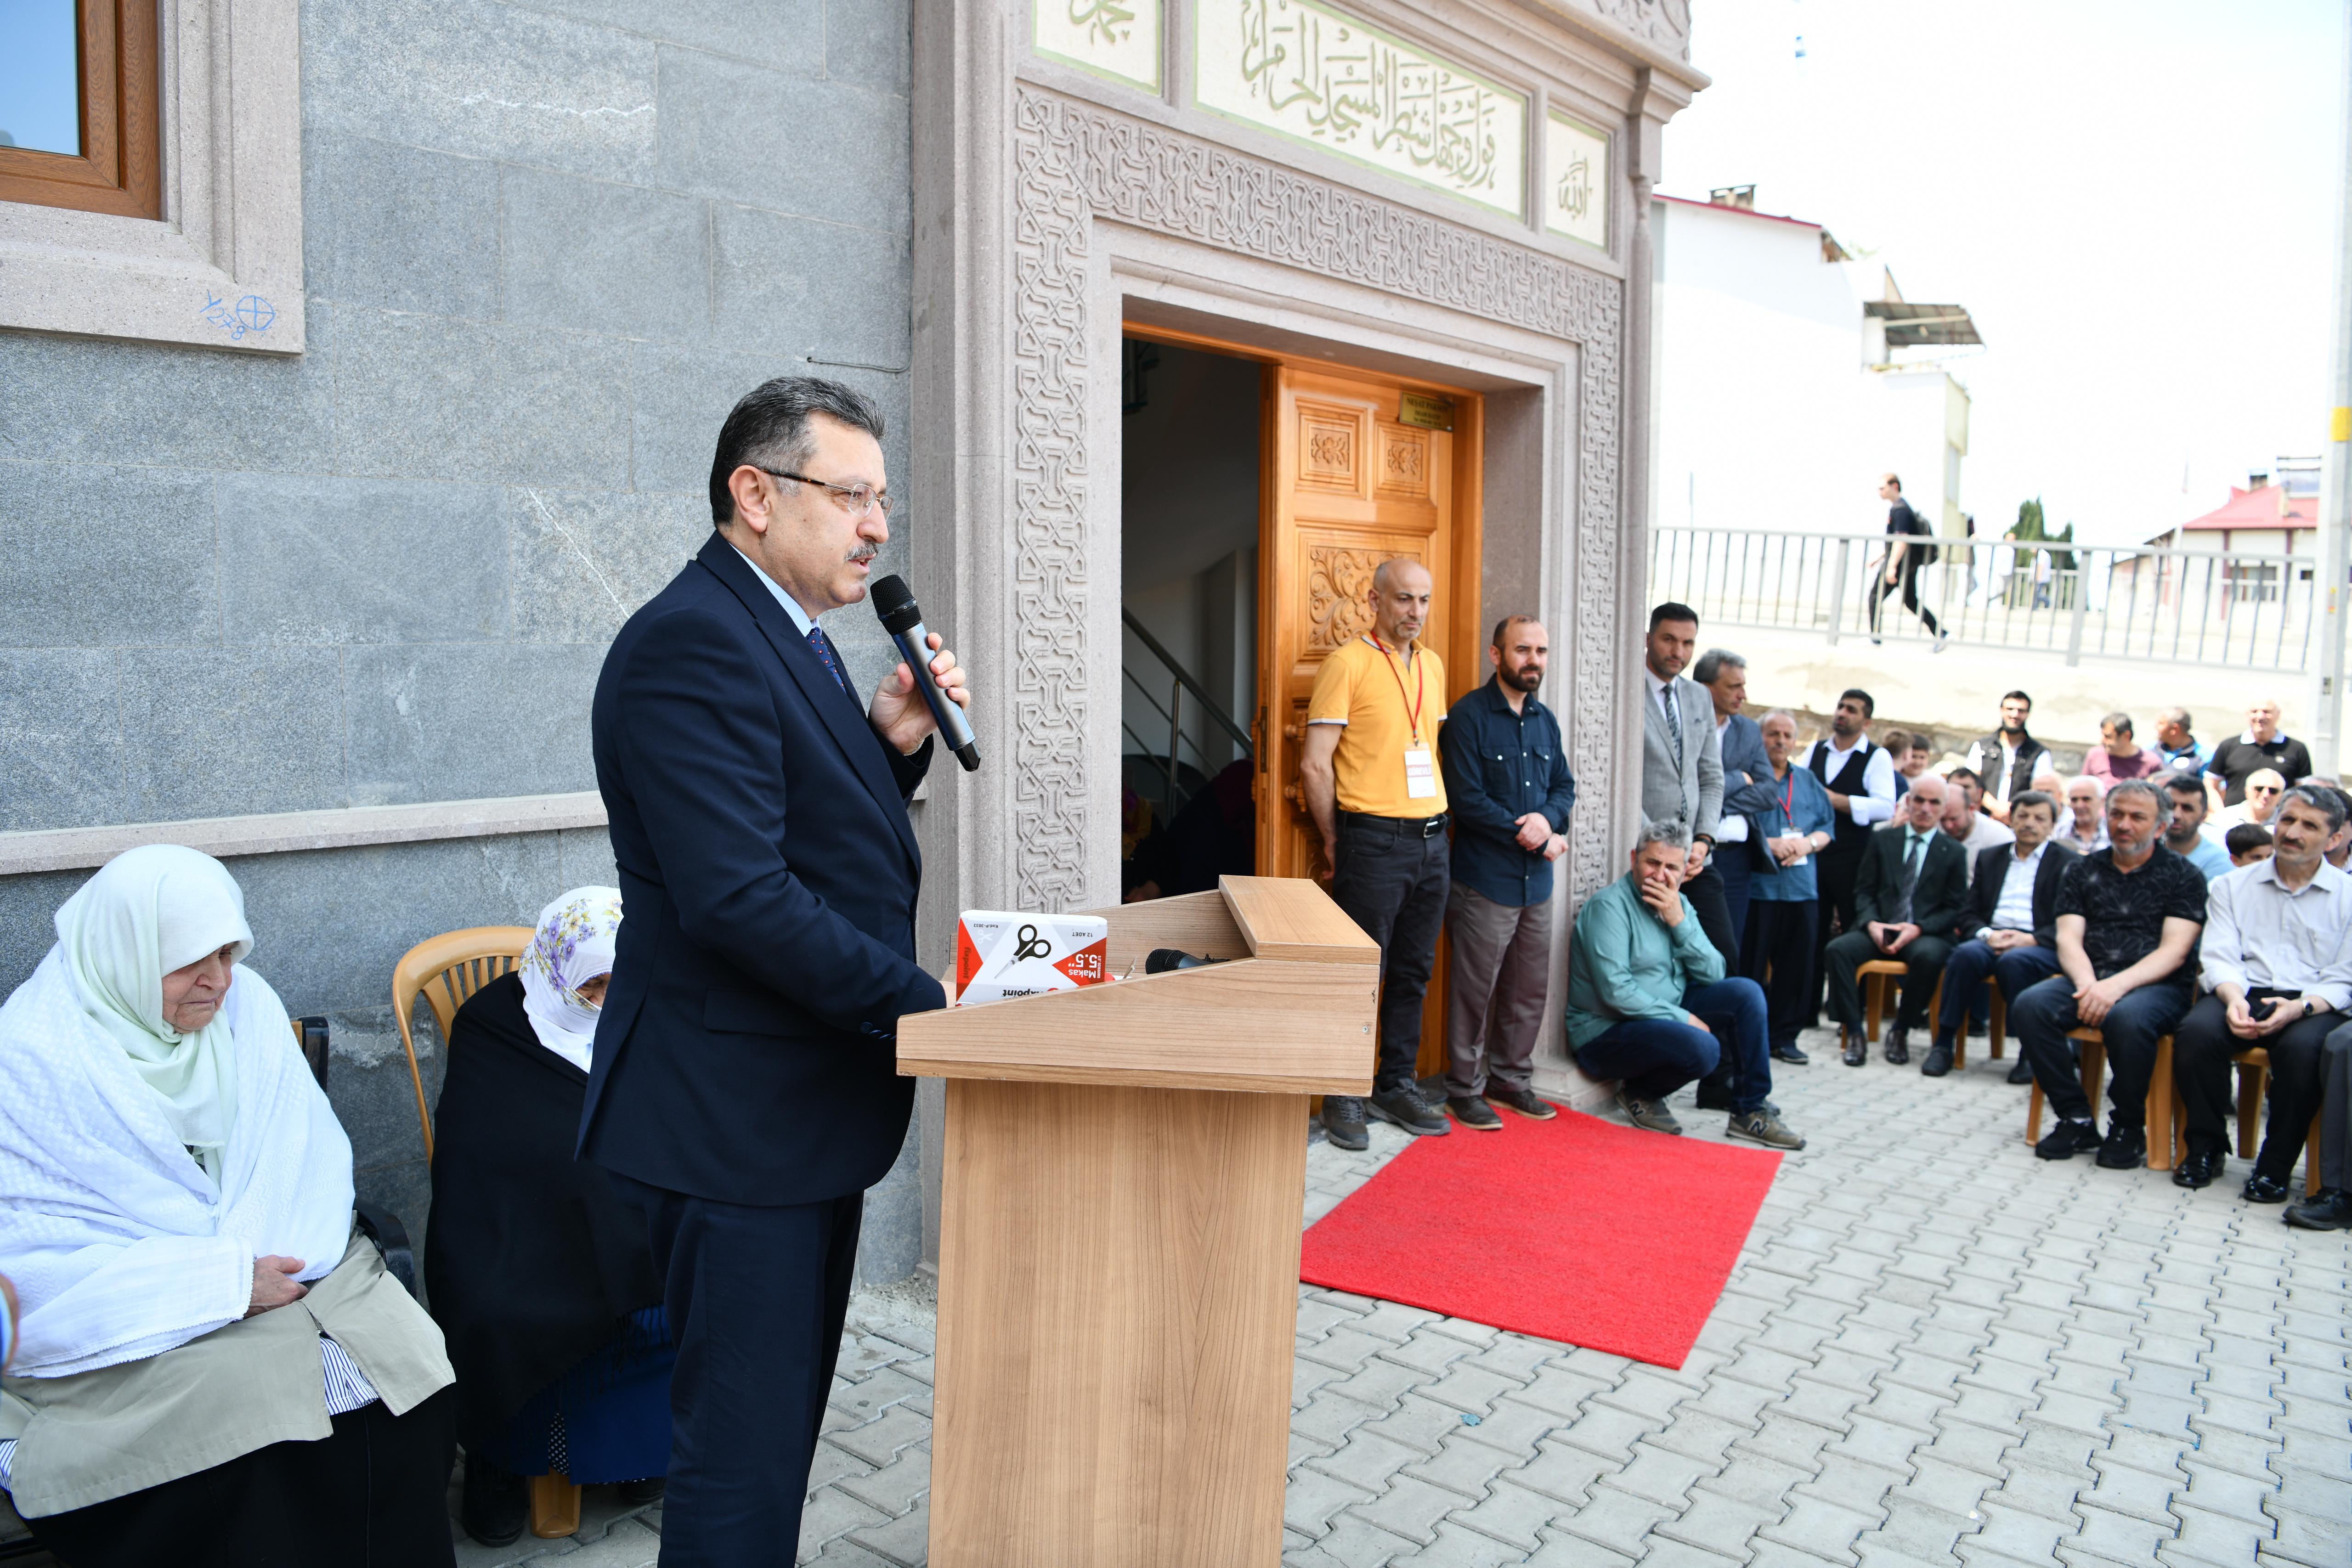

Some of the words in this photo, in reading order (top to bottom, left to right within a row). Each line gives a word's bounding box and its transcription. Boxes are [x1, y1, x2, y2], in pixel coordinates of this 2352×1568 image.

[962, 947, 971, 979] fixpoint
[1068, 969, 1097, 979] Makas
[1002, 988, 1044, 997] point
[1747, 1118, 1770, 1137] N
